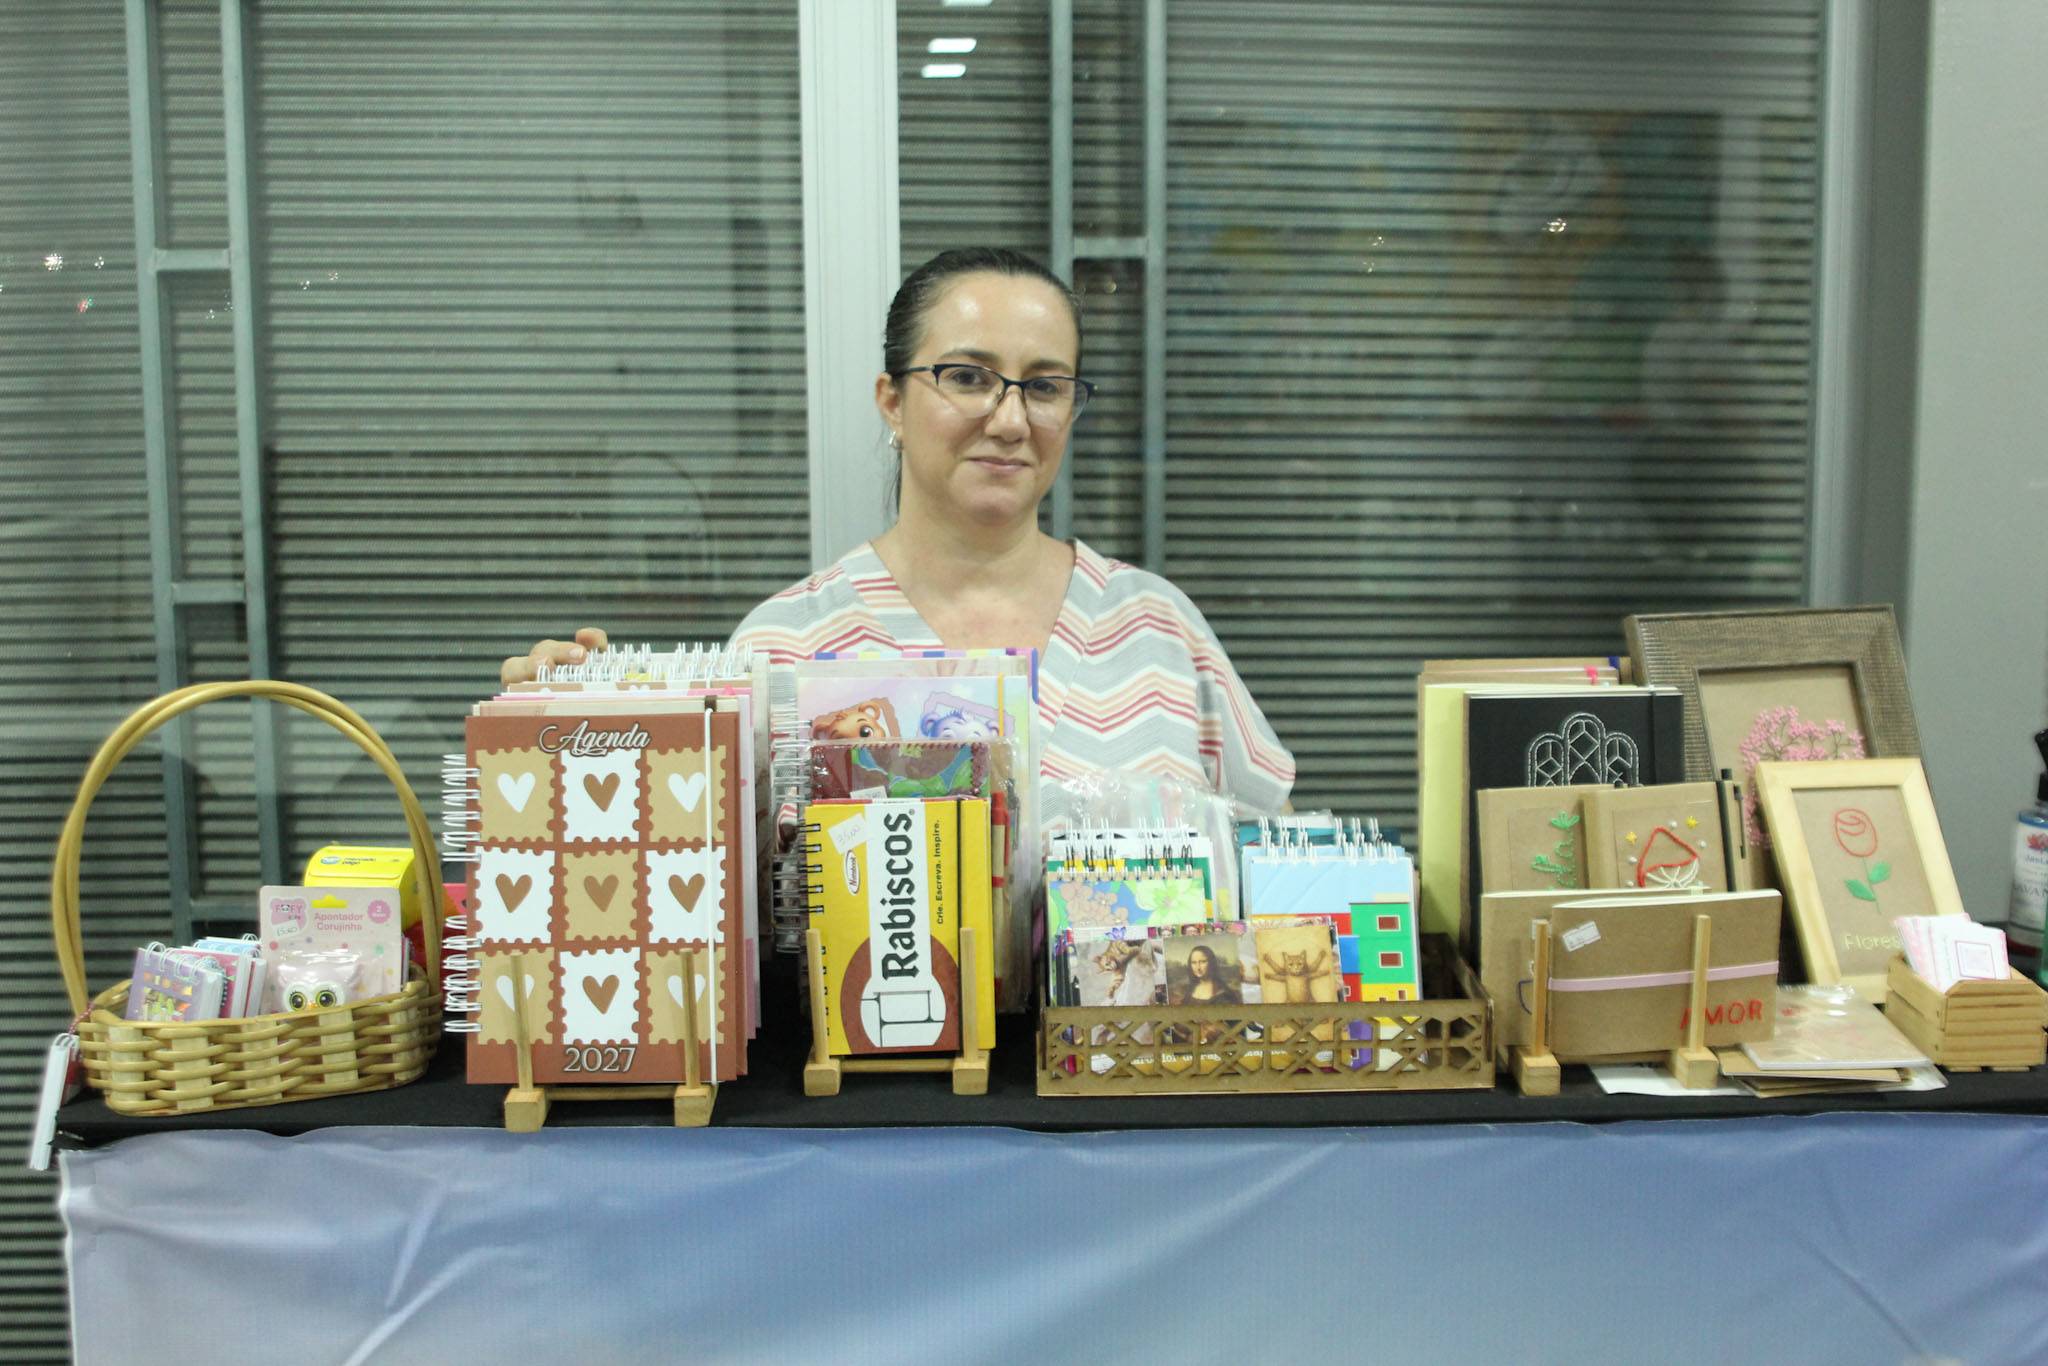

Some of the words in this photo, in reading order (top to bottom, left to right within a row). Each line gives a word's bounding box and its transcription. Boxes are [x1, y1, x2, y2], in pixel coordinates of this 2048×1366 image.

[539, 719, 651, 756] Agenda
[314, 911, 364, 922] Apontador
[563, 1046, 637, 1073] 2027
